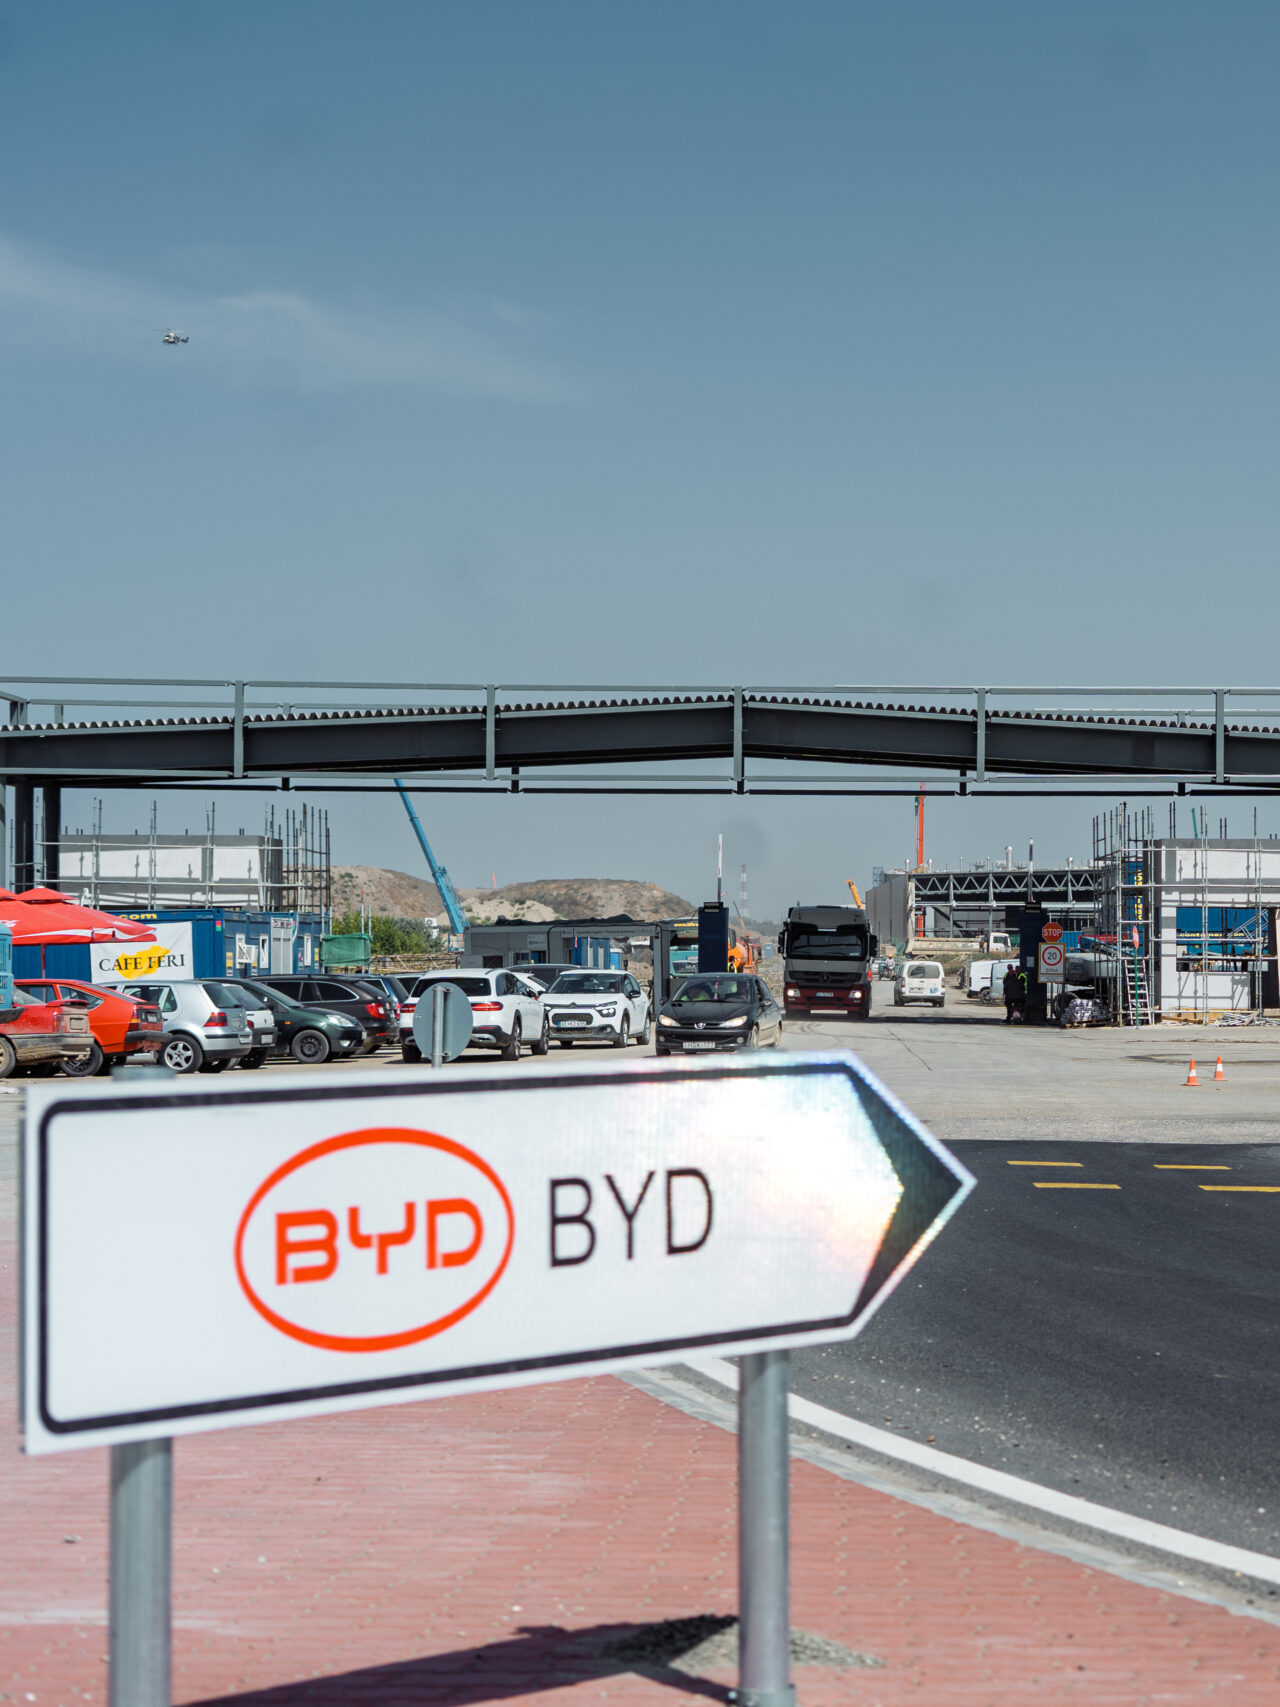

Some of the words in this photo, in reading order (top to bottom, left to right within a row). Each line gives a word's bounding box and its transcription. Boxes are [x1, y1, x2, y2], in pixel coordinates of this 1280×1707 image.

[1043, 928, 1062, 937] STOP
[98, 958, 143, 971] CAFE
[148, 953, 185, 969] FERI
[1047, 952, 1058, 960] 20
[275, 1198, 484, 1285] BYD
[549, 1168, 714, 1268] BYD
